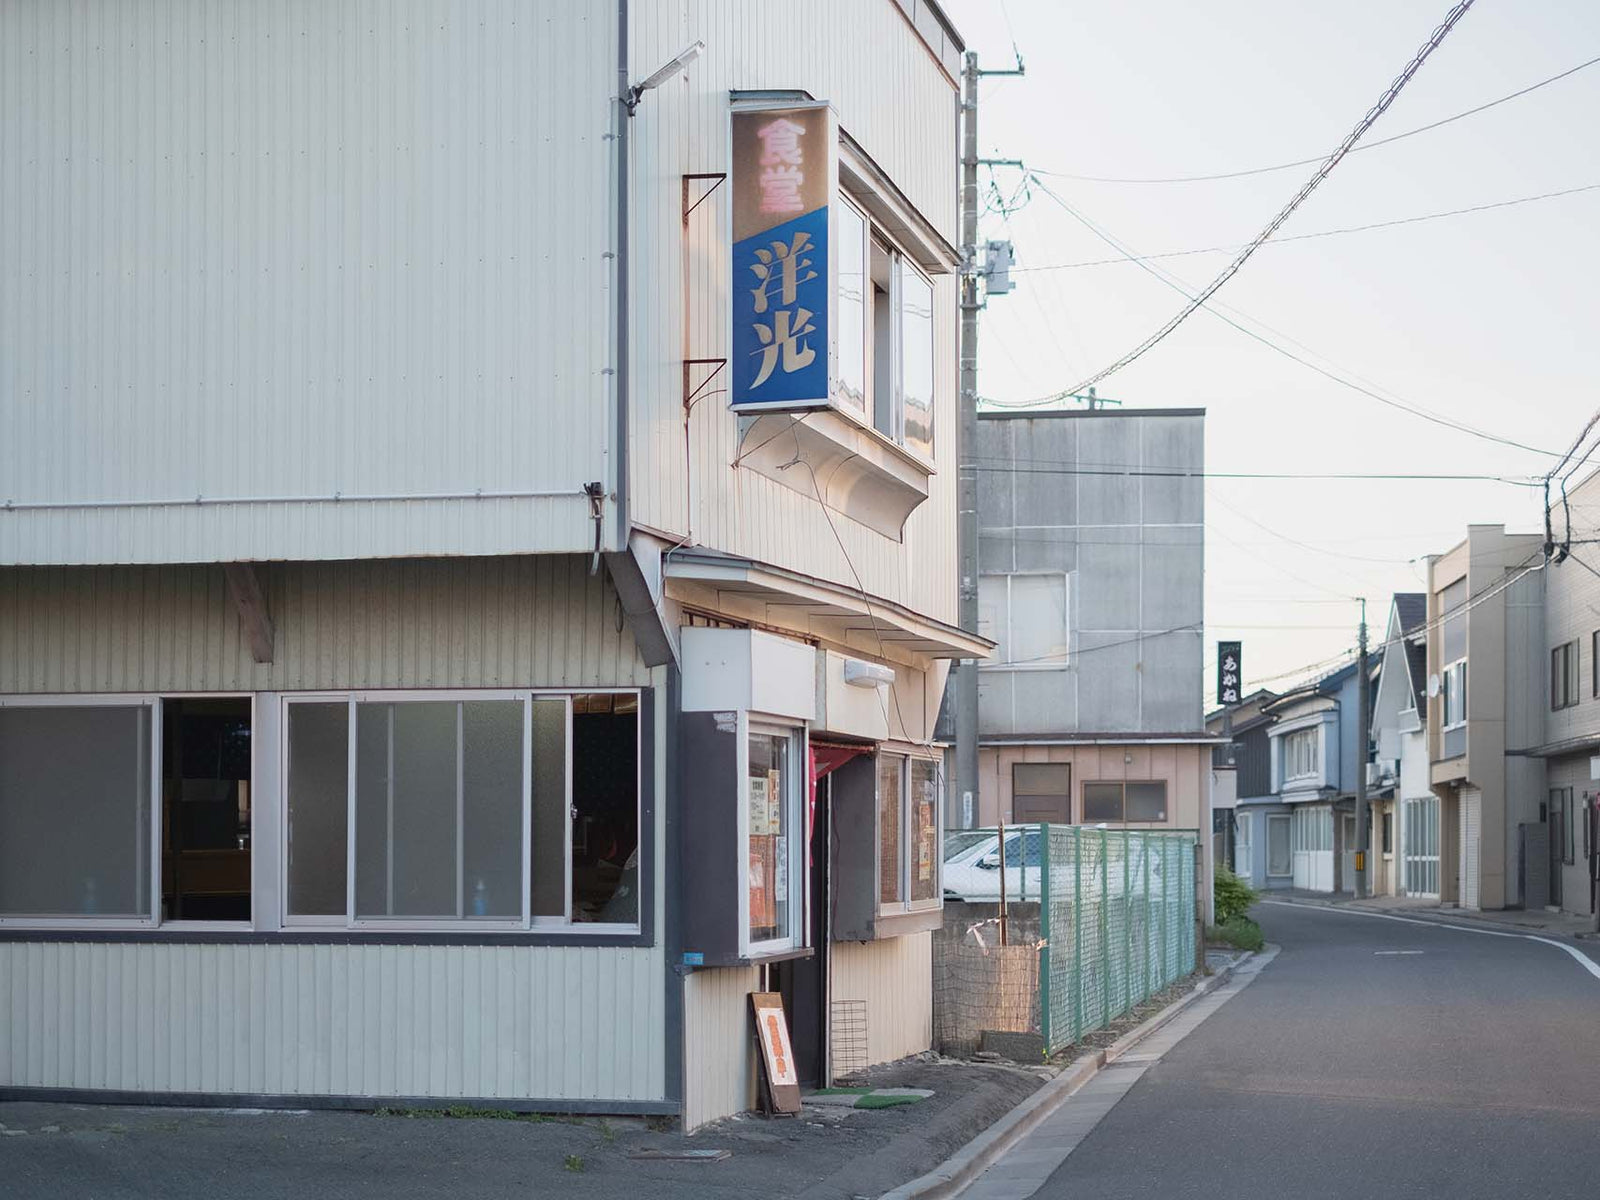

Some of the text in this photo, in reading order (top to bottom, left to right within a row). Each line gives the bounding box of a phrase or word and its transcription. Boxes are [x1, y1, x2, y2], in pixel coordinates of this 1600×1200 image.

[757, 118, 806, 213] 食堂
[749, 232, 818, 390] 洋光
[1223, 655, 1237, 702] あかね
